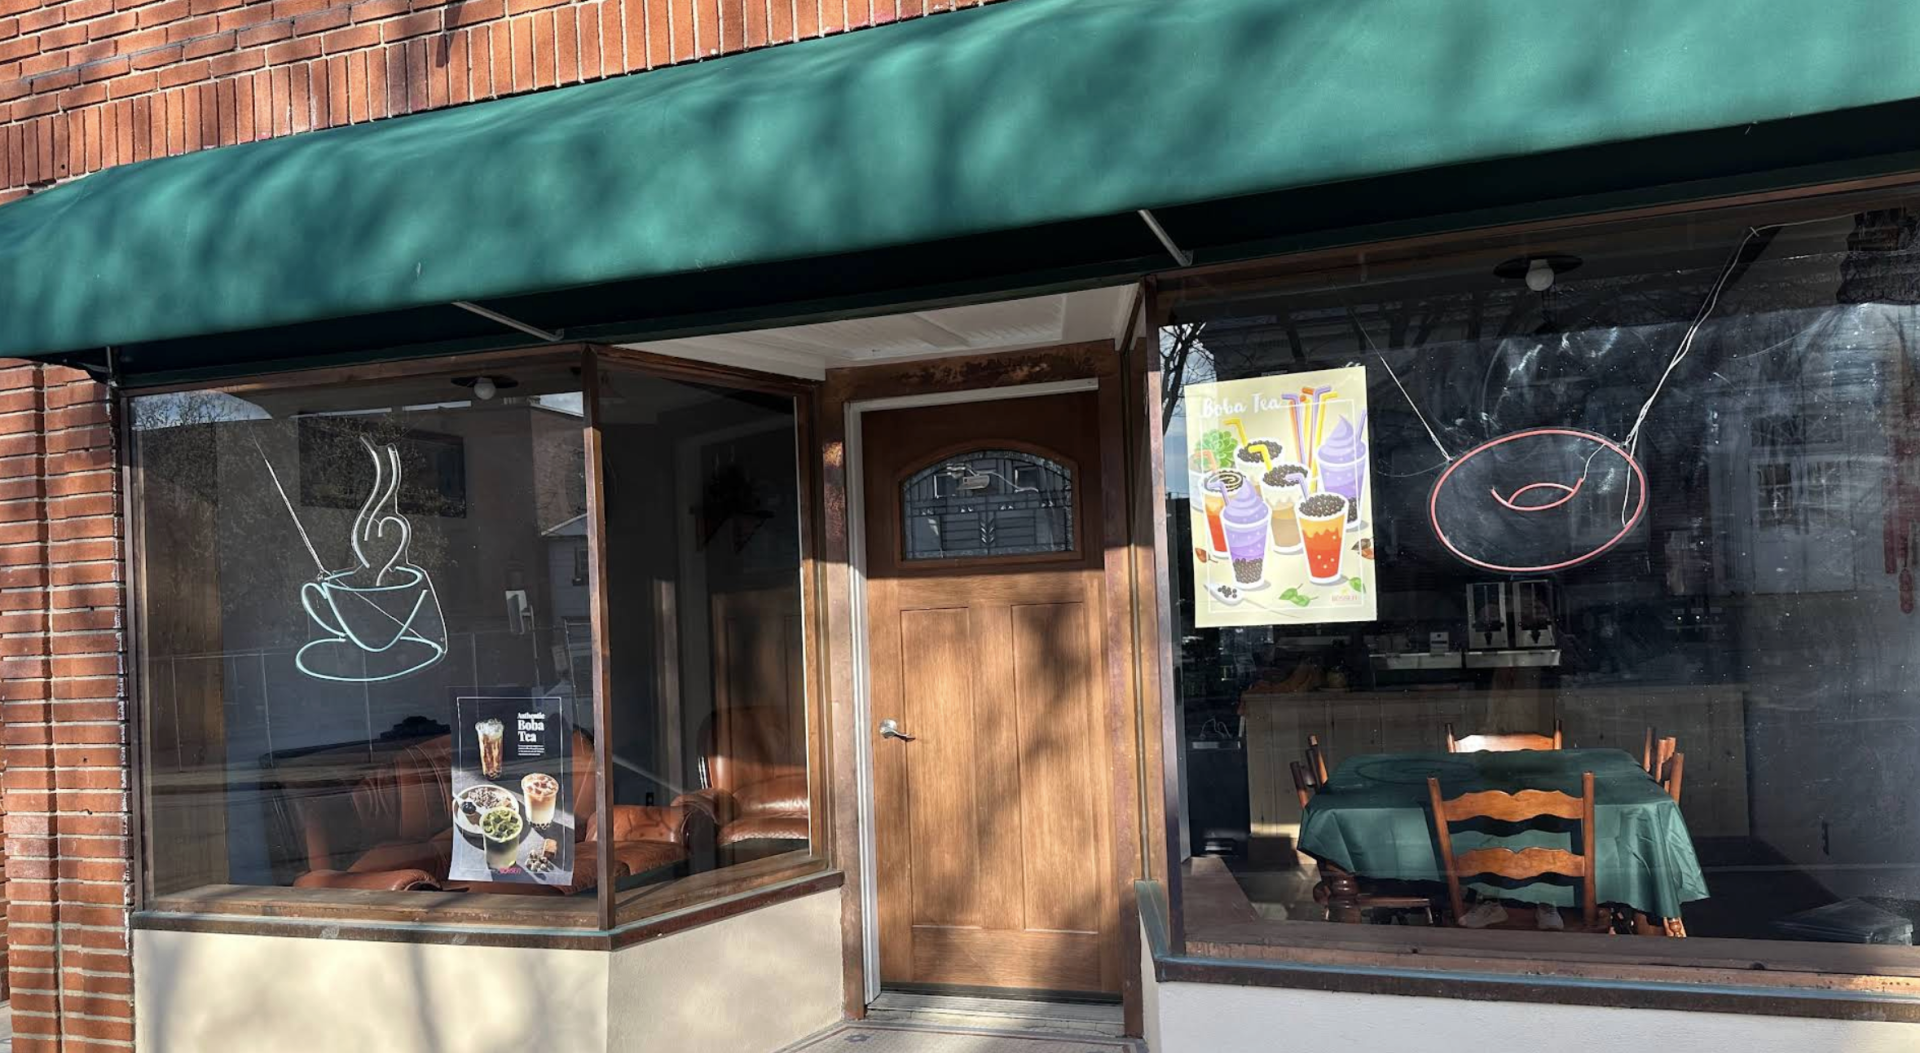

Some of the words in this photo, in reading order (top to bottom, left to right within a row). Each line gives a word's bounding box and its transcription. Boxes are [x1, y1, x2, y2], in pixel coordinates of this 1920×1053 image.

[1202, 397, 1247, 418] Boba
[1252, 392, 1281, 413] Tea
[517, 711, 545, 719] Authentic
[517, 719, 544, 731] Boba
[517, 731, 537, 742] Tea
